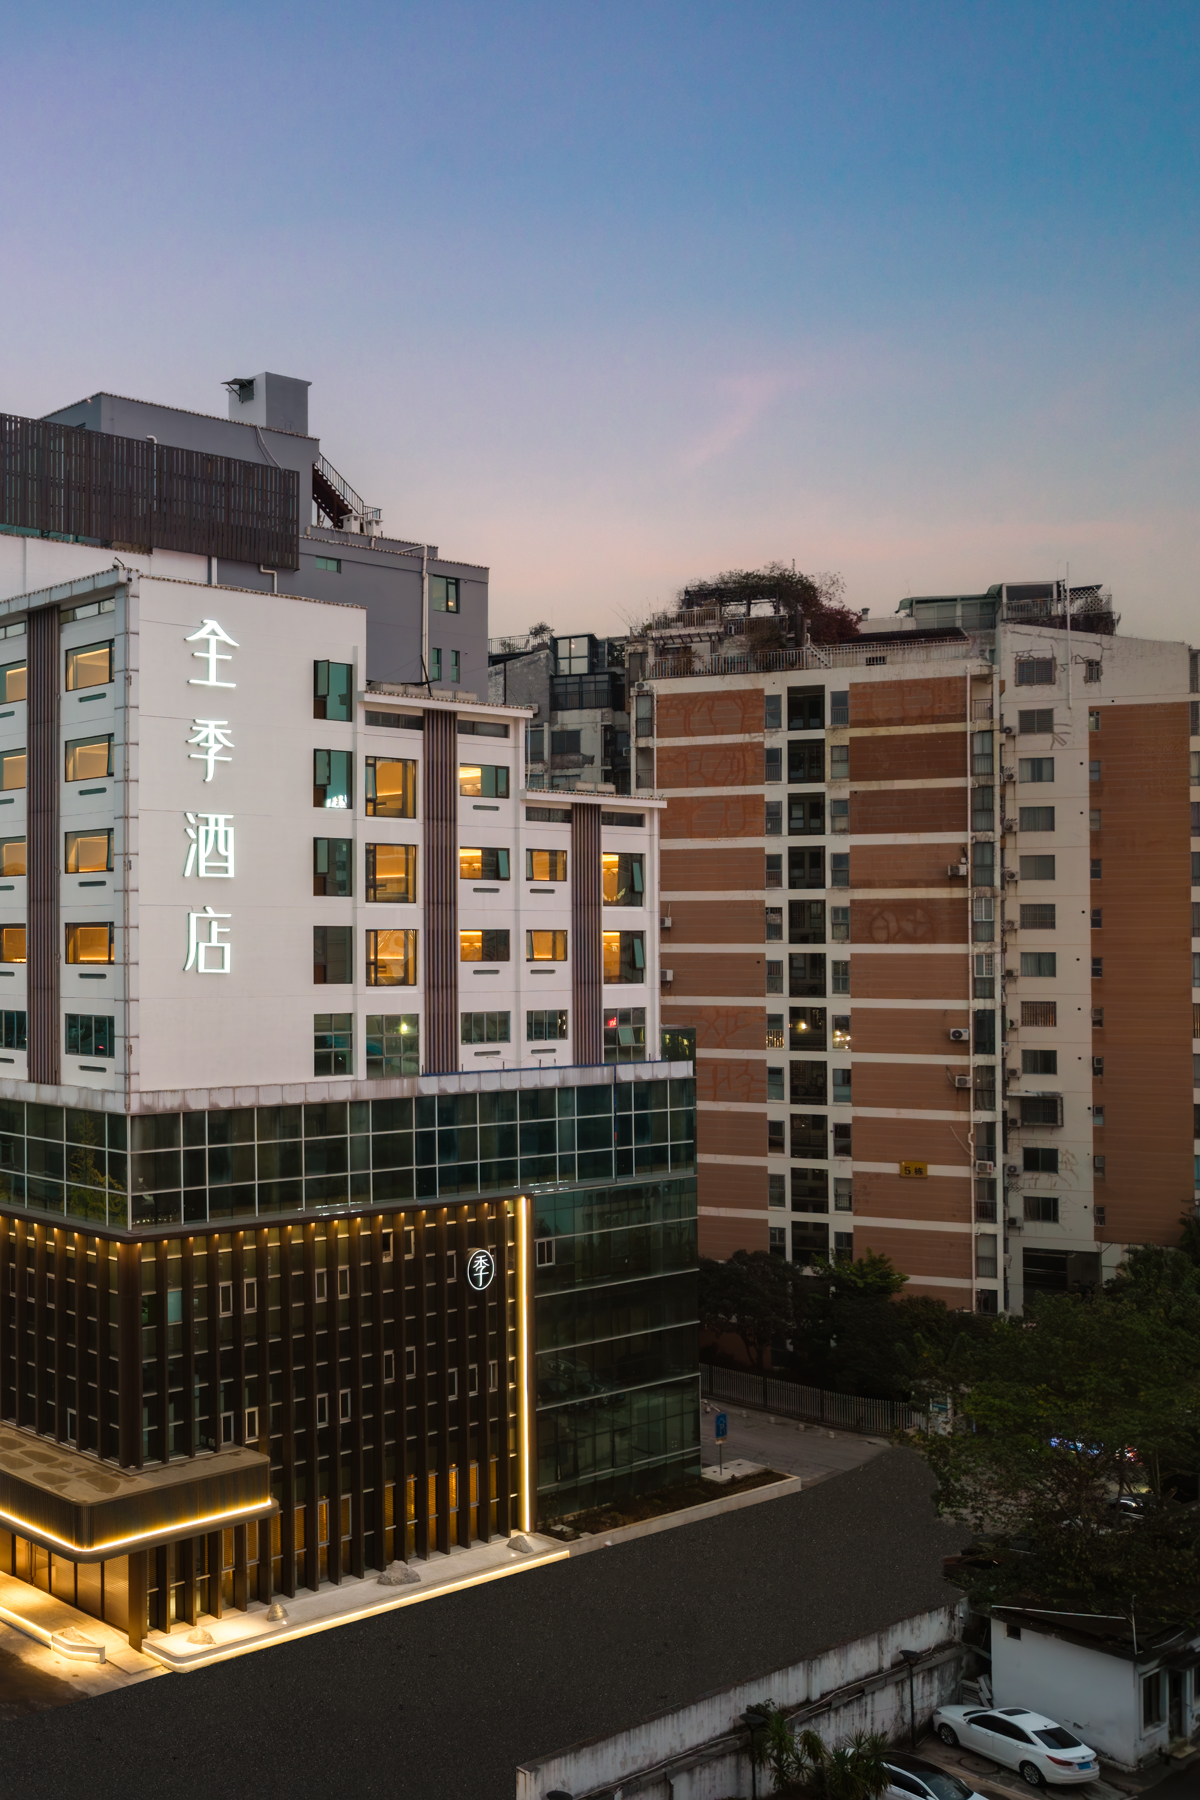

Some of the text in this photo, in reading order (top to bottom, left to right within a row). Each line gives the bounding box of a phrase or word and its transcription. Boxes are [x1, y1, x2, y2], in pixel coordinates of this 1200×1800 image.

[183, 618, 240, 975] 全季酒店
[472, 1254, 490, 1287] 季
